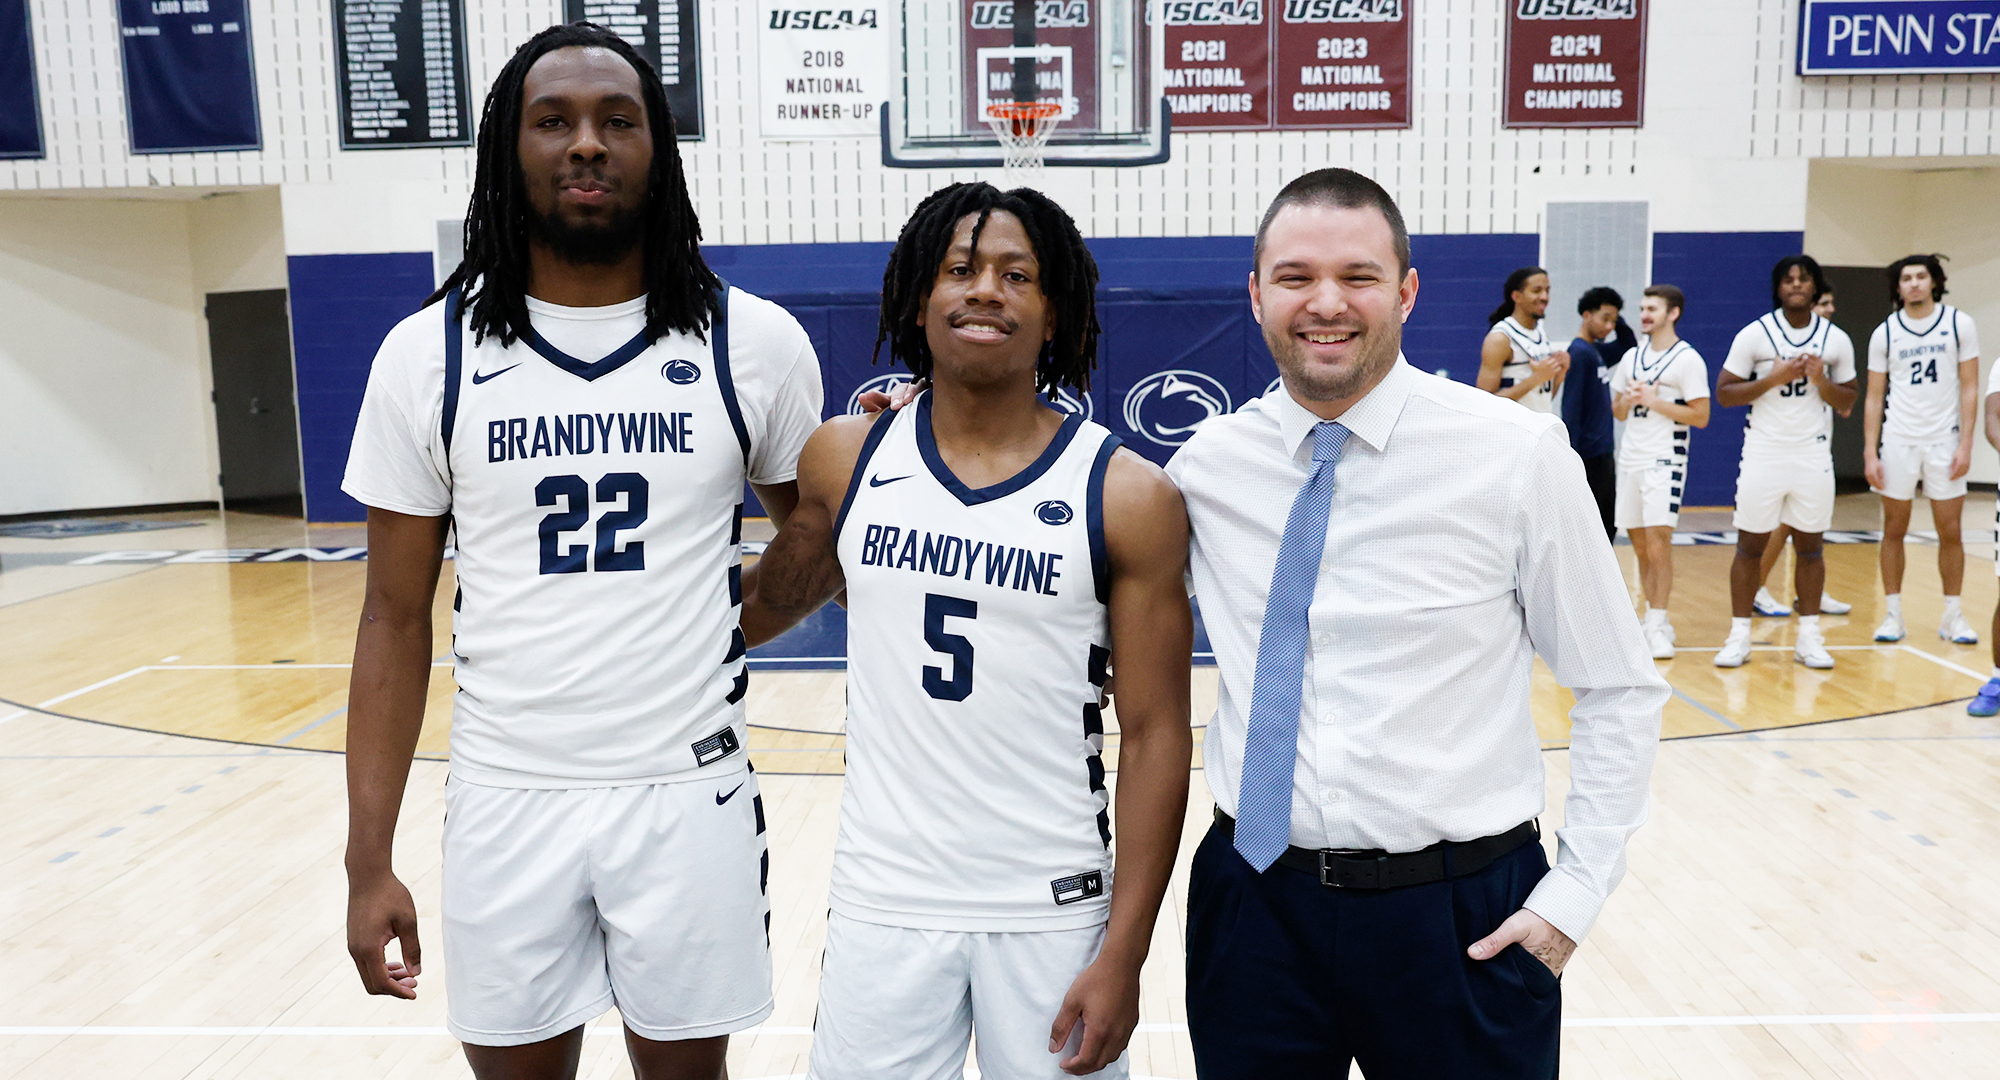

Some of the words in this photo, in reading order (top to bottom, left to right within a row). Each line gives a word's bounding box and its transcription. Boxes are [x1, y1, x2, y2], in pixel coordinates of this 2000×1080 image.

[769, 9, 877, 30] USCAA
[972, 2, 1088, 27] USAA
[1284, 0, 1402, 22] USCAA
[1550, 34, 1601, 57] 2024
[1827, 14, 1935, 56] PENN
[1181, 39, 1226, 62] 2021
[1317, 37, 1368, 59] 2023
[803, 50, 844, 68] 2018
[1163, 67, 1245, 88] NATIONAL
[1301, 65, 1384, 85] NATIONAL
[1533, 62, 1616, 83] NATIONAL
[786, 78, 864, 94] NATIONAL
[1166, 93, 1253, 113] HAMPIONS
[1293, 91, 1391, 111] CHAMPIONS
[1524, 89, 1623, 109] CHAMPIONS
[777, 103, 873, 119] RUNNER-UP
[1911, 358, 1938, 385] 24
[488, 412, 694, 463] BRANDYWINE
[534, 472, 650, 576] 22
[68, 546, 368, 565] PEN
[861, 523, 1063, 597] BRANDYWINE
[922, 592, 978, 702] 5
[723, 737, 733, 748] L
[1087, 878, 1098, 890] M
